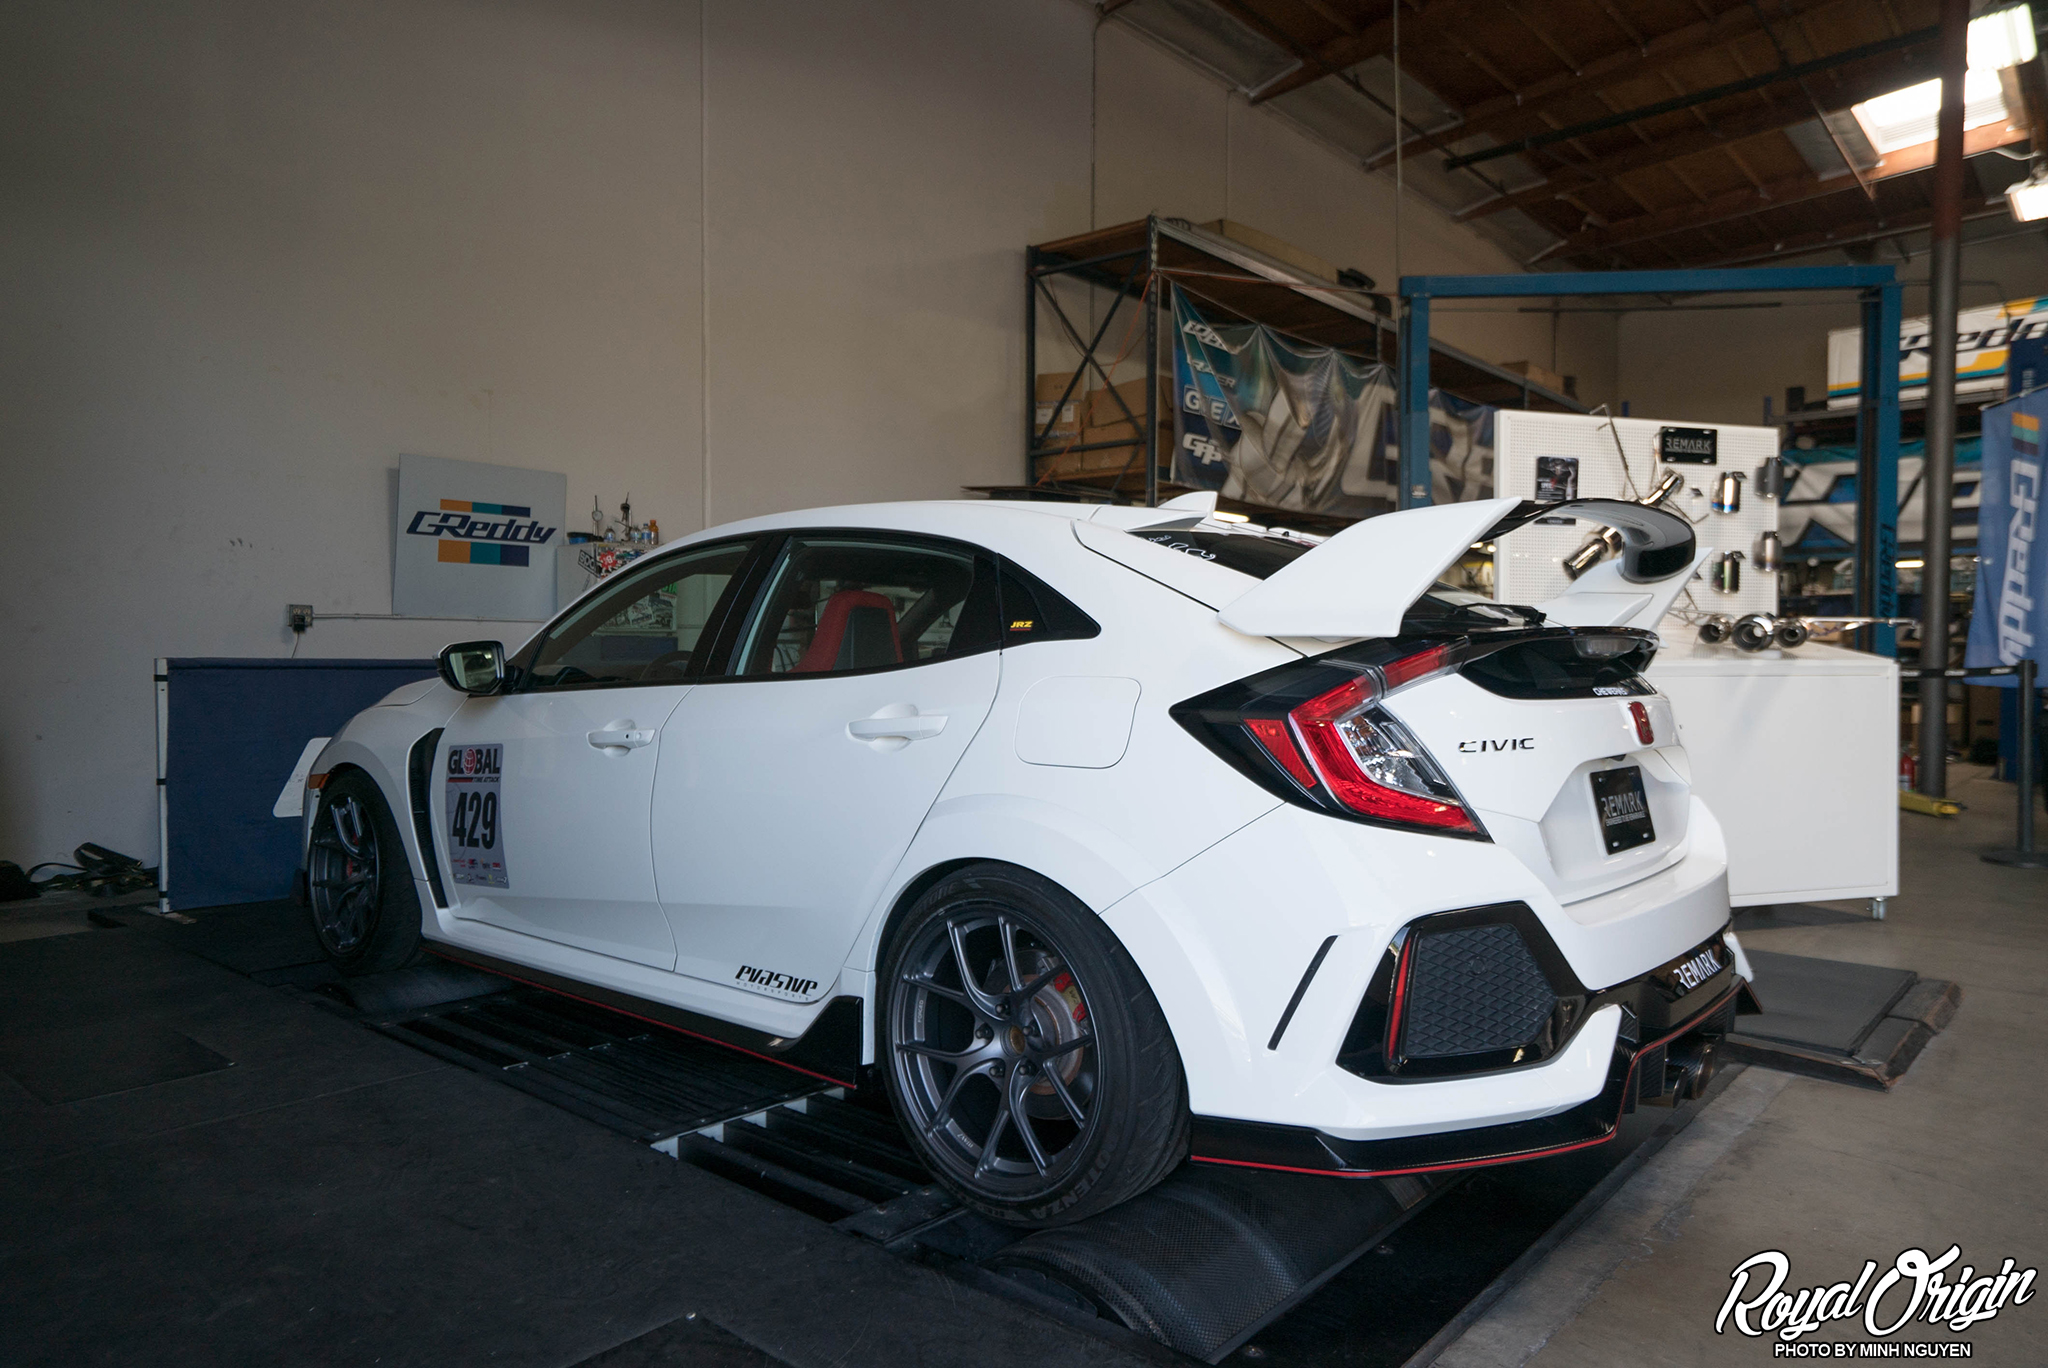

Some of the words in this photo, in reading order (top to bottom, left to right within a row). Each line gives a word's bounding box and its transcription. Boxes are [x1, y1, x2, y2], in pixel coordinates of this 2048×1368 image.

[1665, 437, 1712, 451] REMARK
[406, 511, 557, 544] GReddy
[1010, 620, 1034, 629] JRZ
[1458, 737, 1535, 753] CIVIC
[448, 748, 500, 776] GLOBAL
[1600, 790, 1645, 818] REMARK
[452, 791, 497, 850] 429
[1672, 949, 1723, 990] REMARK
